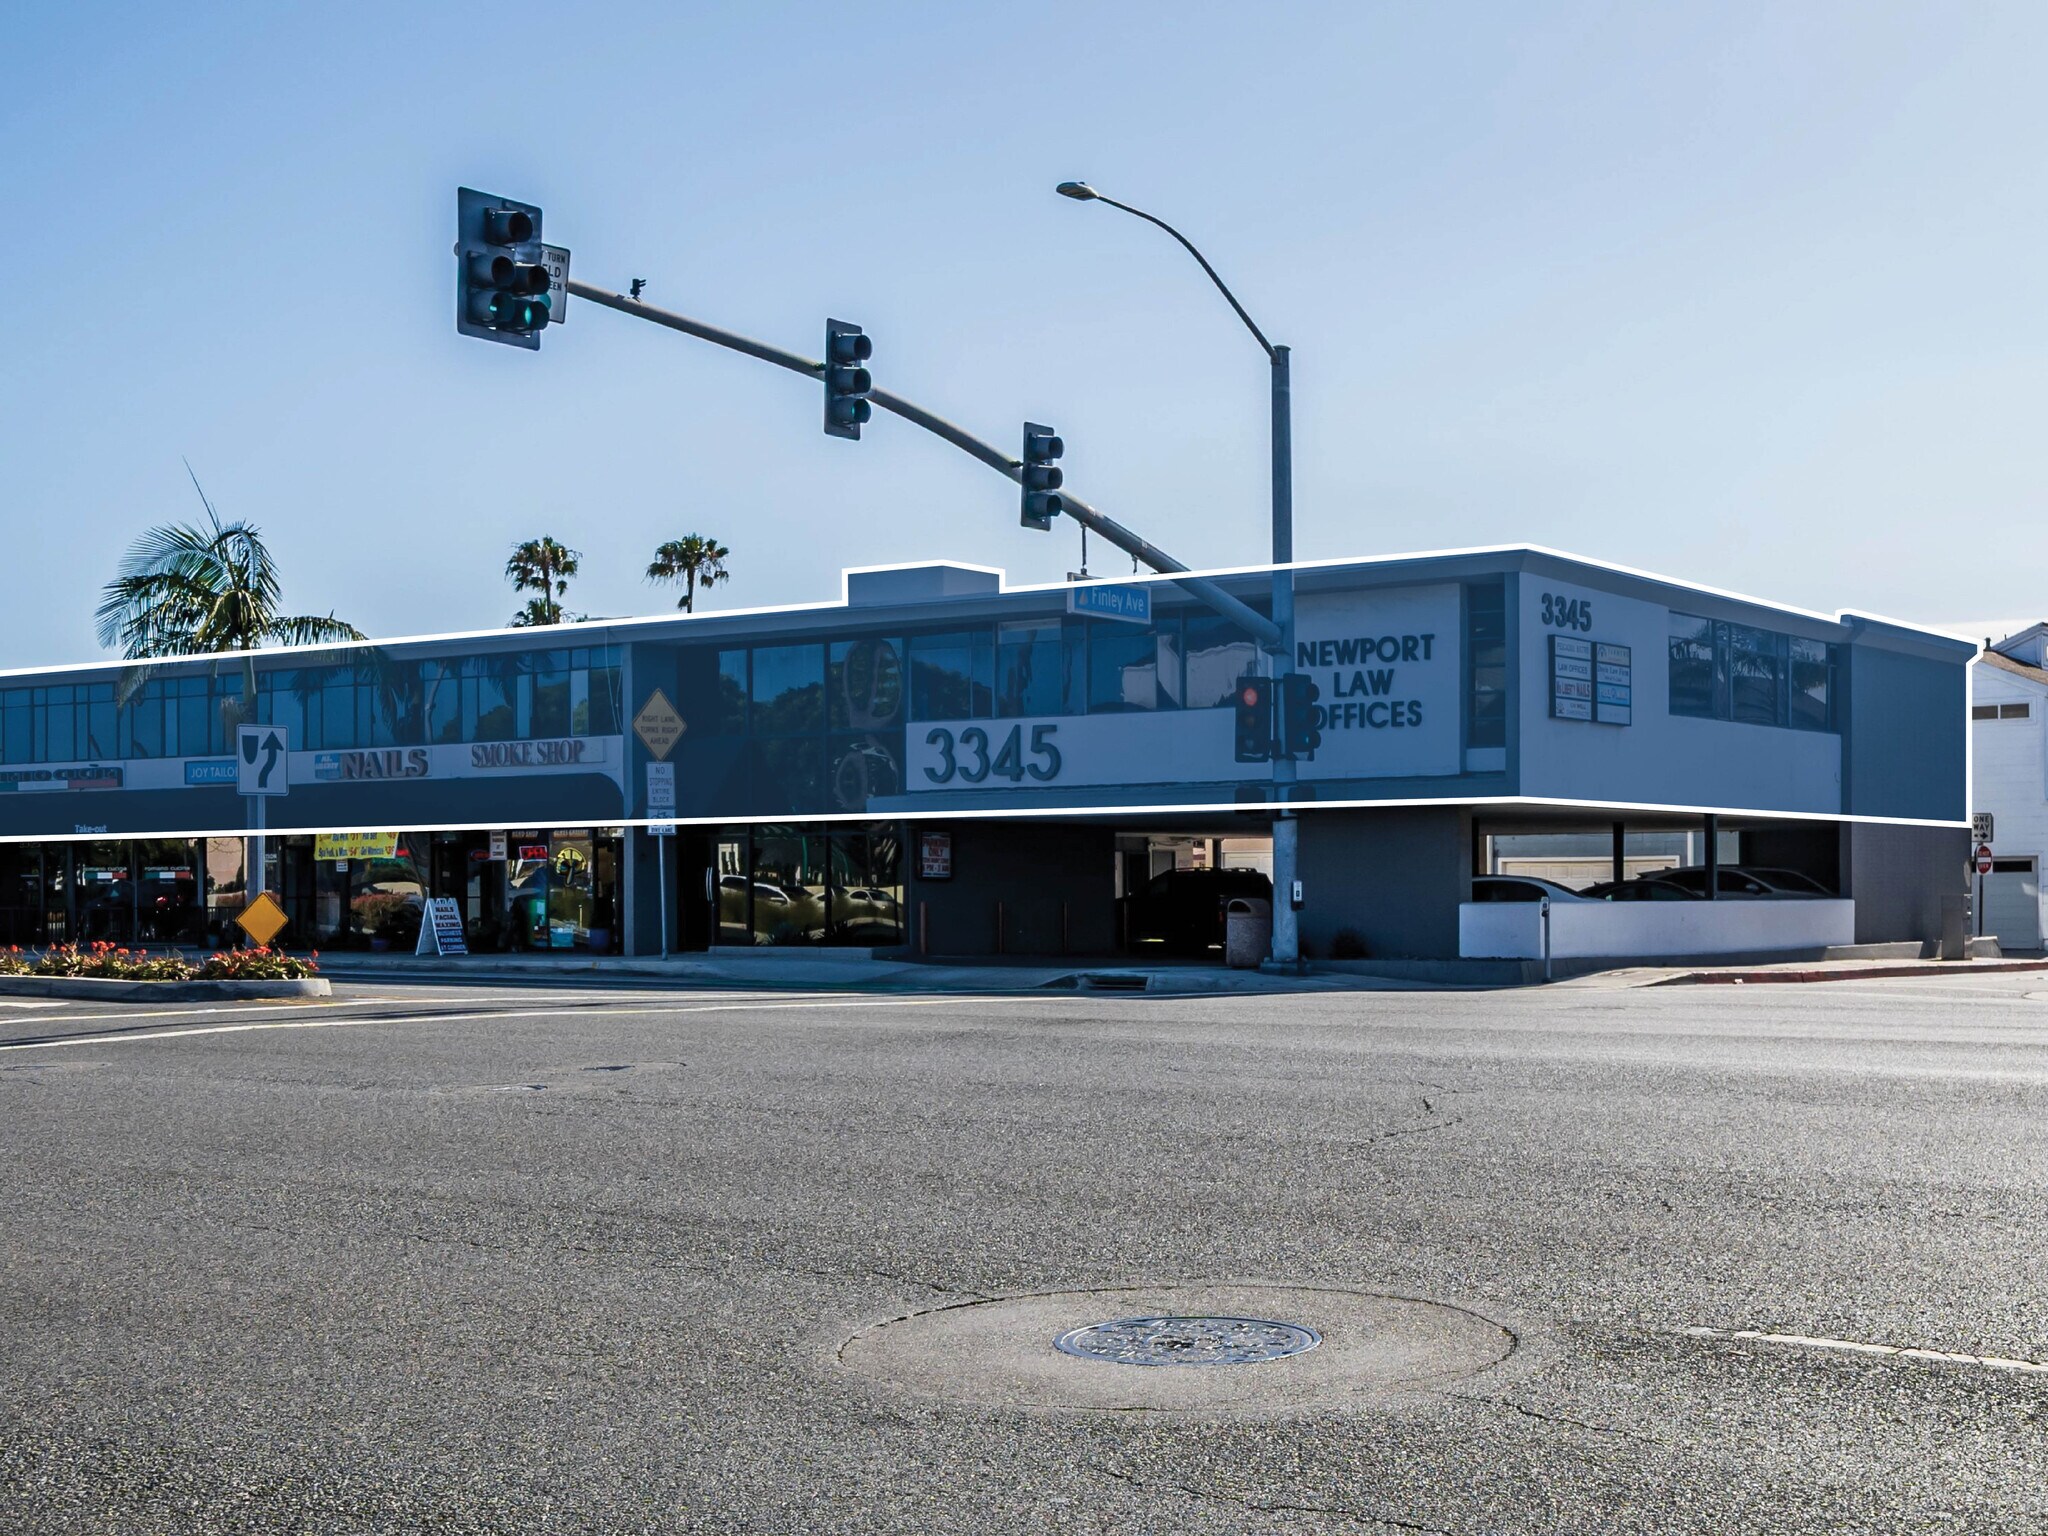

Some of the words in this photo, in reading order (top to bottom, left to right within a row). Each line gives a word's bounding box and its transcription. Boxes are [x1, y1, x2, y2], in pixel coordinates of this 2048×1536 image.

[548, 252, 565, 263] TURN
[1092, 587, 1123, 613] Finley
[1126, 592, 1144, 612] Ave
[1541, 592, 1593, 632] 3345
[1297, 634, 1435, 667] NEWPORT
[1334, 669, 1394, 697] LAW
[642, 715, 658, 723] RIGHT
[661, 715, 675, 723] LANE
[650, 737, 669, 745] AHEAD
[472, 742, 533, 768] SMOKE
[537, 740, 585, 765] SHOP
[923, 724, 1062, 784] 3345
[191, 767, 208, 778] JOY
[210, 766, 238, 778] TAILO
[341, 749, 428, 779] NAILS
[655, 766, 665, 774] NO
[649, 777, 672, 787] STOPPING
[75, 824, 107, 833] Take-out
